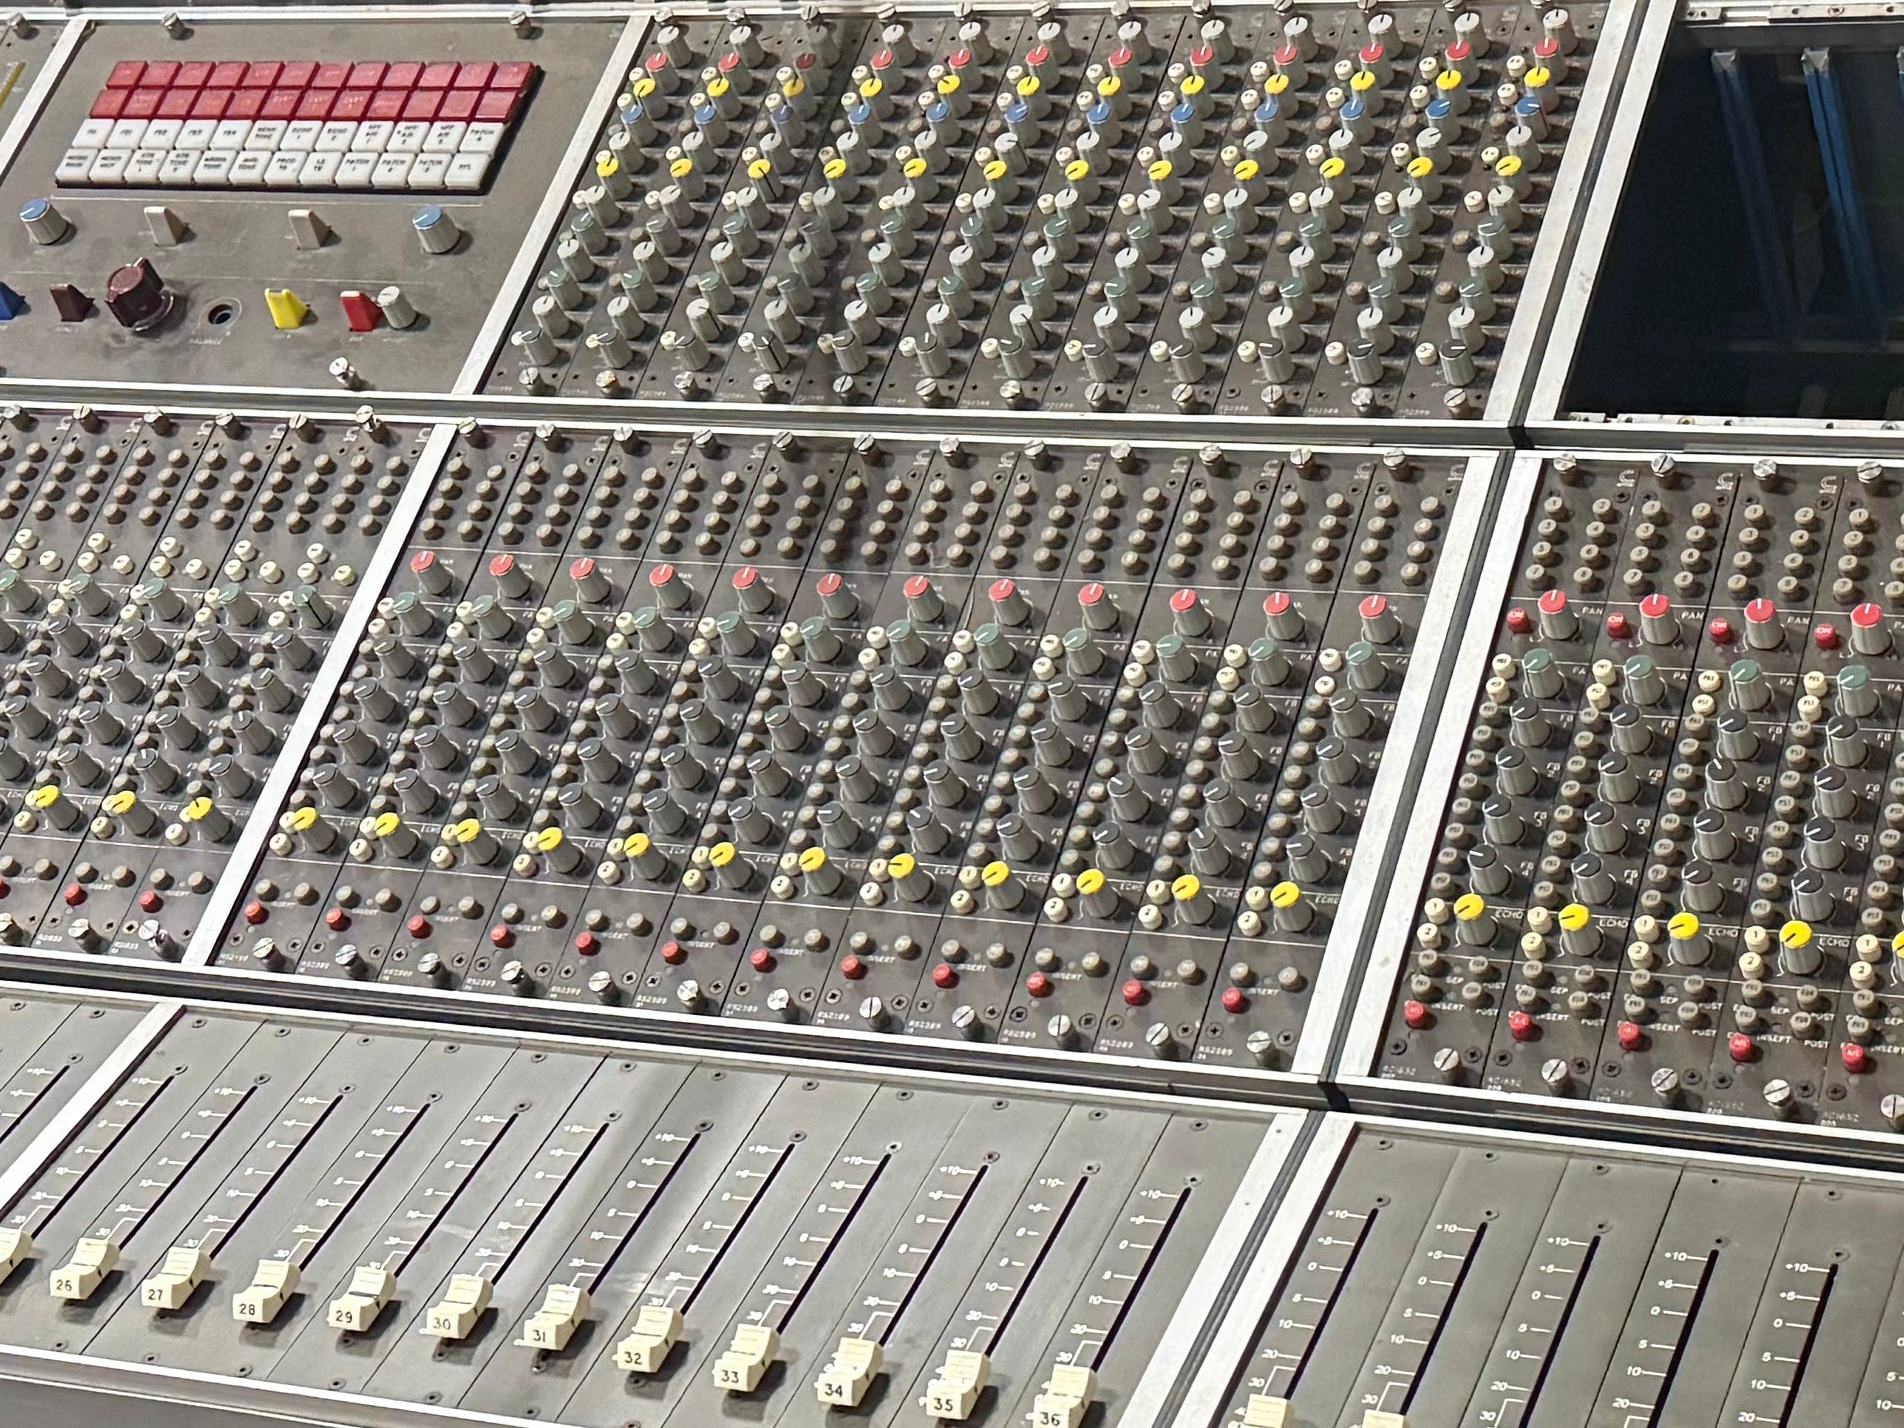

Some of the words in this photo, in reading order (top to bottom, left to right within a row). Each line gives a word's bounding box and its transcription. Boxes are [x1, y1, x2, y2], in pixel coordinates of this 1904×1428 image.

[1582, 607, 1604, 615] PAN
[1682, 611, 1704, 620] PAN
[1495, 910, 1524, 920] ECHO
[1599, 919, 1629, 928] ECHO
[1709, 927, 1739, 938] ECHO
[1327, 1210, 1347, 1219] +10
[1308, 1262, 1317, 1270] 0
[56, 1278, 73, 1292] 26
[146, 1287, 164, 1301] 27
[1292, 1294, 1302, 1303] 5
[239, 1302, 256, 1316] 28
[335, 1308, 353, 1323] 29
[433, 1316, 451, 1331] 30
[1279, 1319, 1293, 1328] 10
[532, 1329, 548, 1342] 31
[625, 1350, 642, 1365] 32
[1261, 1348, 1279, 1359] 20
[721, 1367, 740, 1383] 33
[1887, 1372, 1896, 1381] 5
[824, 1382, 843, 1397] 34
[934, 1397, 954, 1411] 35
[1876, 1400, 1893, 1410] 10
[1040, 1412, 1061, 1427] 36
